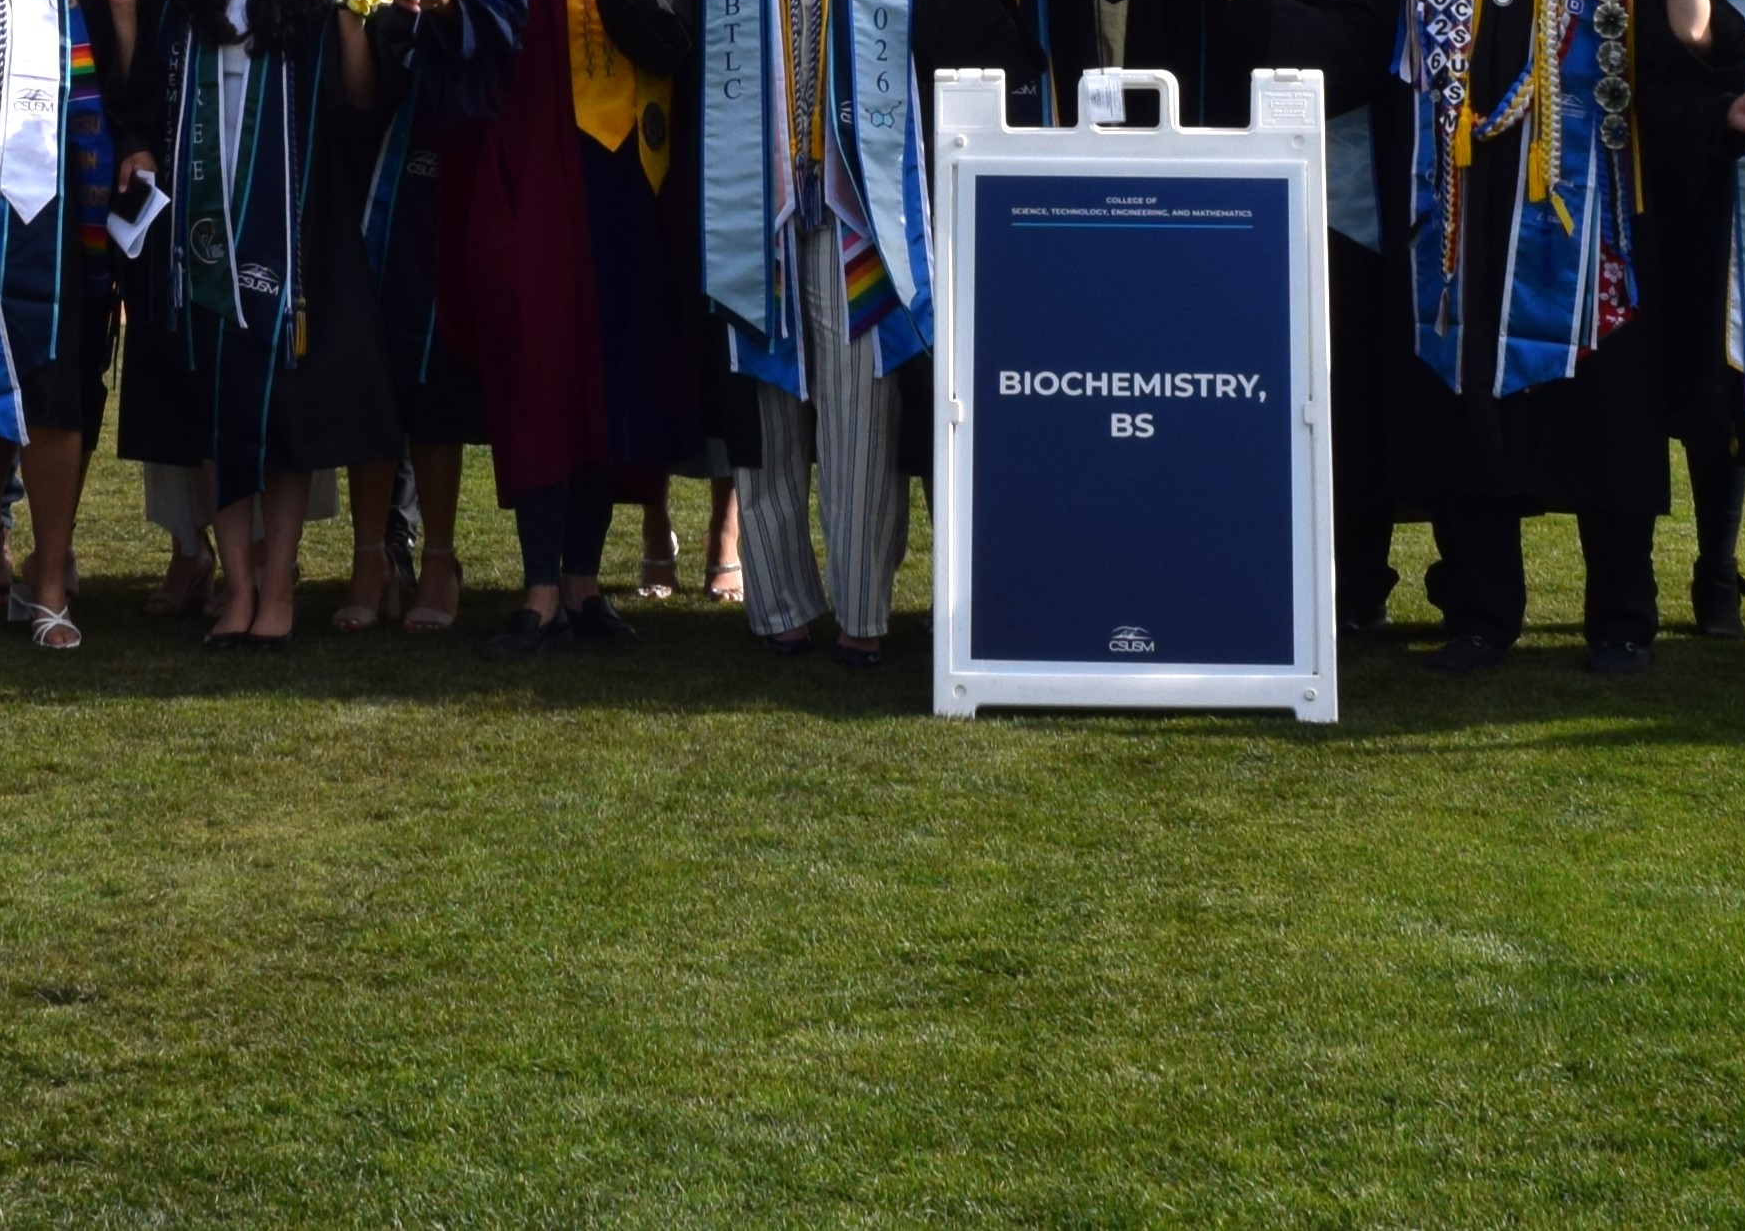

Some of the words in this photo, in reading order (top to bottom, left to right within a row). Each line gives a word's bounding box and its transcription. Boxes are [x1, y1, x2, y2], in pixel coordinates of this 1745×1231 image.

[1444, 2, 1469, 128] CSUSM
[14, 100, 54, 112] CSUSM
[164, 40, 181, 183] CHEMISTRY
[406, 161, 438, 178] CSUS
[1106, 197, 1143, 205] COLLEGE
[1145, 197, 1157, 205] OF
[1011, 208, 1049, 216] SCIENCE,
[1051, 208, 1110, 217] TECHNOLOGY,
[1111, 209, 1170, 217] ENGINEERING,
[1171, 209, 1190, 217] AND
[1192, 209, 1253, 217] MATHEMATICS
[238, 274, 279, 296] CSUSM
[999, 370, 1266, 403] BIOCHEMISTRY,
[1111, 412, 1155, 437] BS
[1108, 640, 1155, 652] CSUSM
